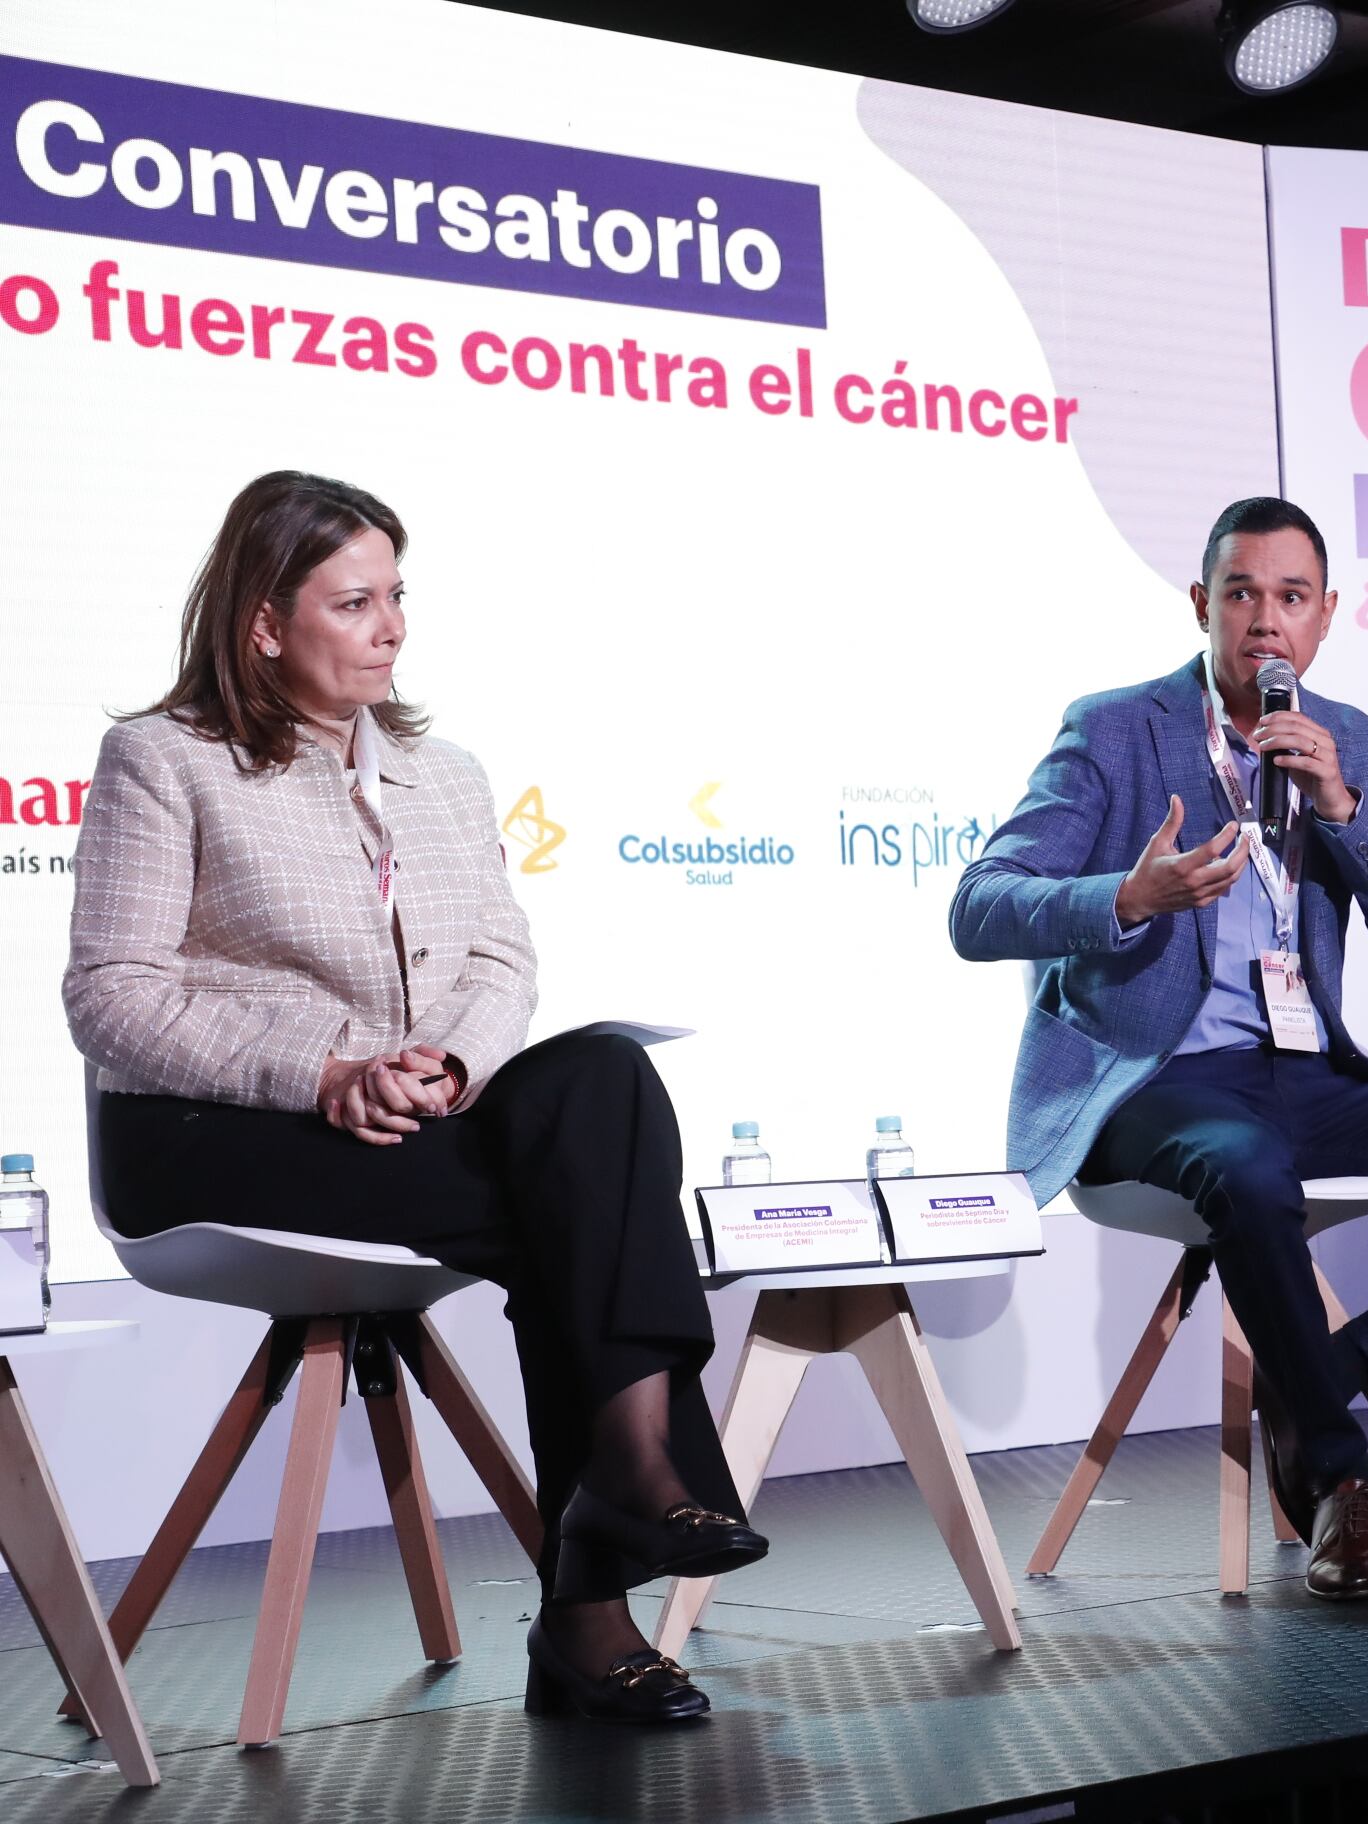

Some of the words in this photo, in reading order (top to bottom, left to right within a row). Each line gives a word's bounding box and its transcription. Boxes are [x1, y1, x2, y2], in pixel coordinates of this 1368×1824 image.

[14, 98, 782, 292] Conversatorio
[82, 260, 438, 377] fuerzas
[460, 330, 728, 409] contra
[748, 347, 813, 417] el
[834, 360, 1078, 443] cáncer
[842, 786, 934, 803] FUNDACIÓN
[618, 834, 794, 865] Colsubsidio
[686, 869, 733, 885] Salud
[935, 1200, 957, 1208] Diego
[761, 1210, 778, 1218] Ana
[778, 1208, 802, 1217] María
[745, 1231, 782, 1241] Empresas
